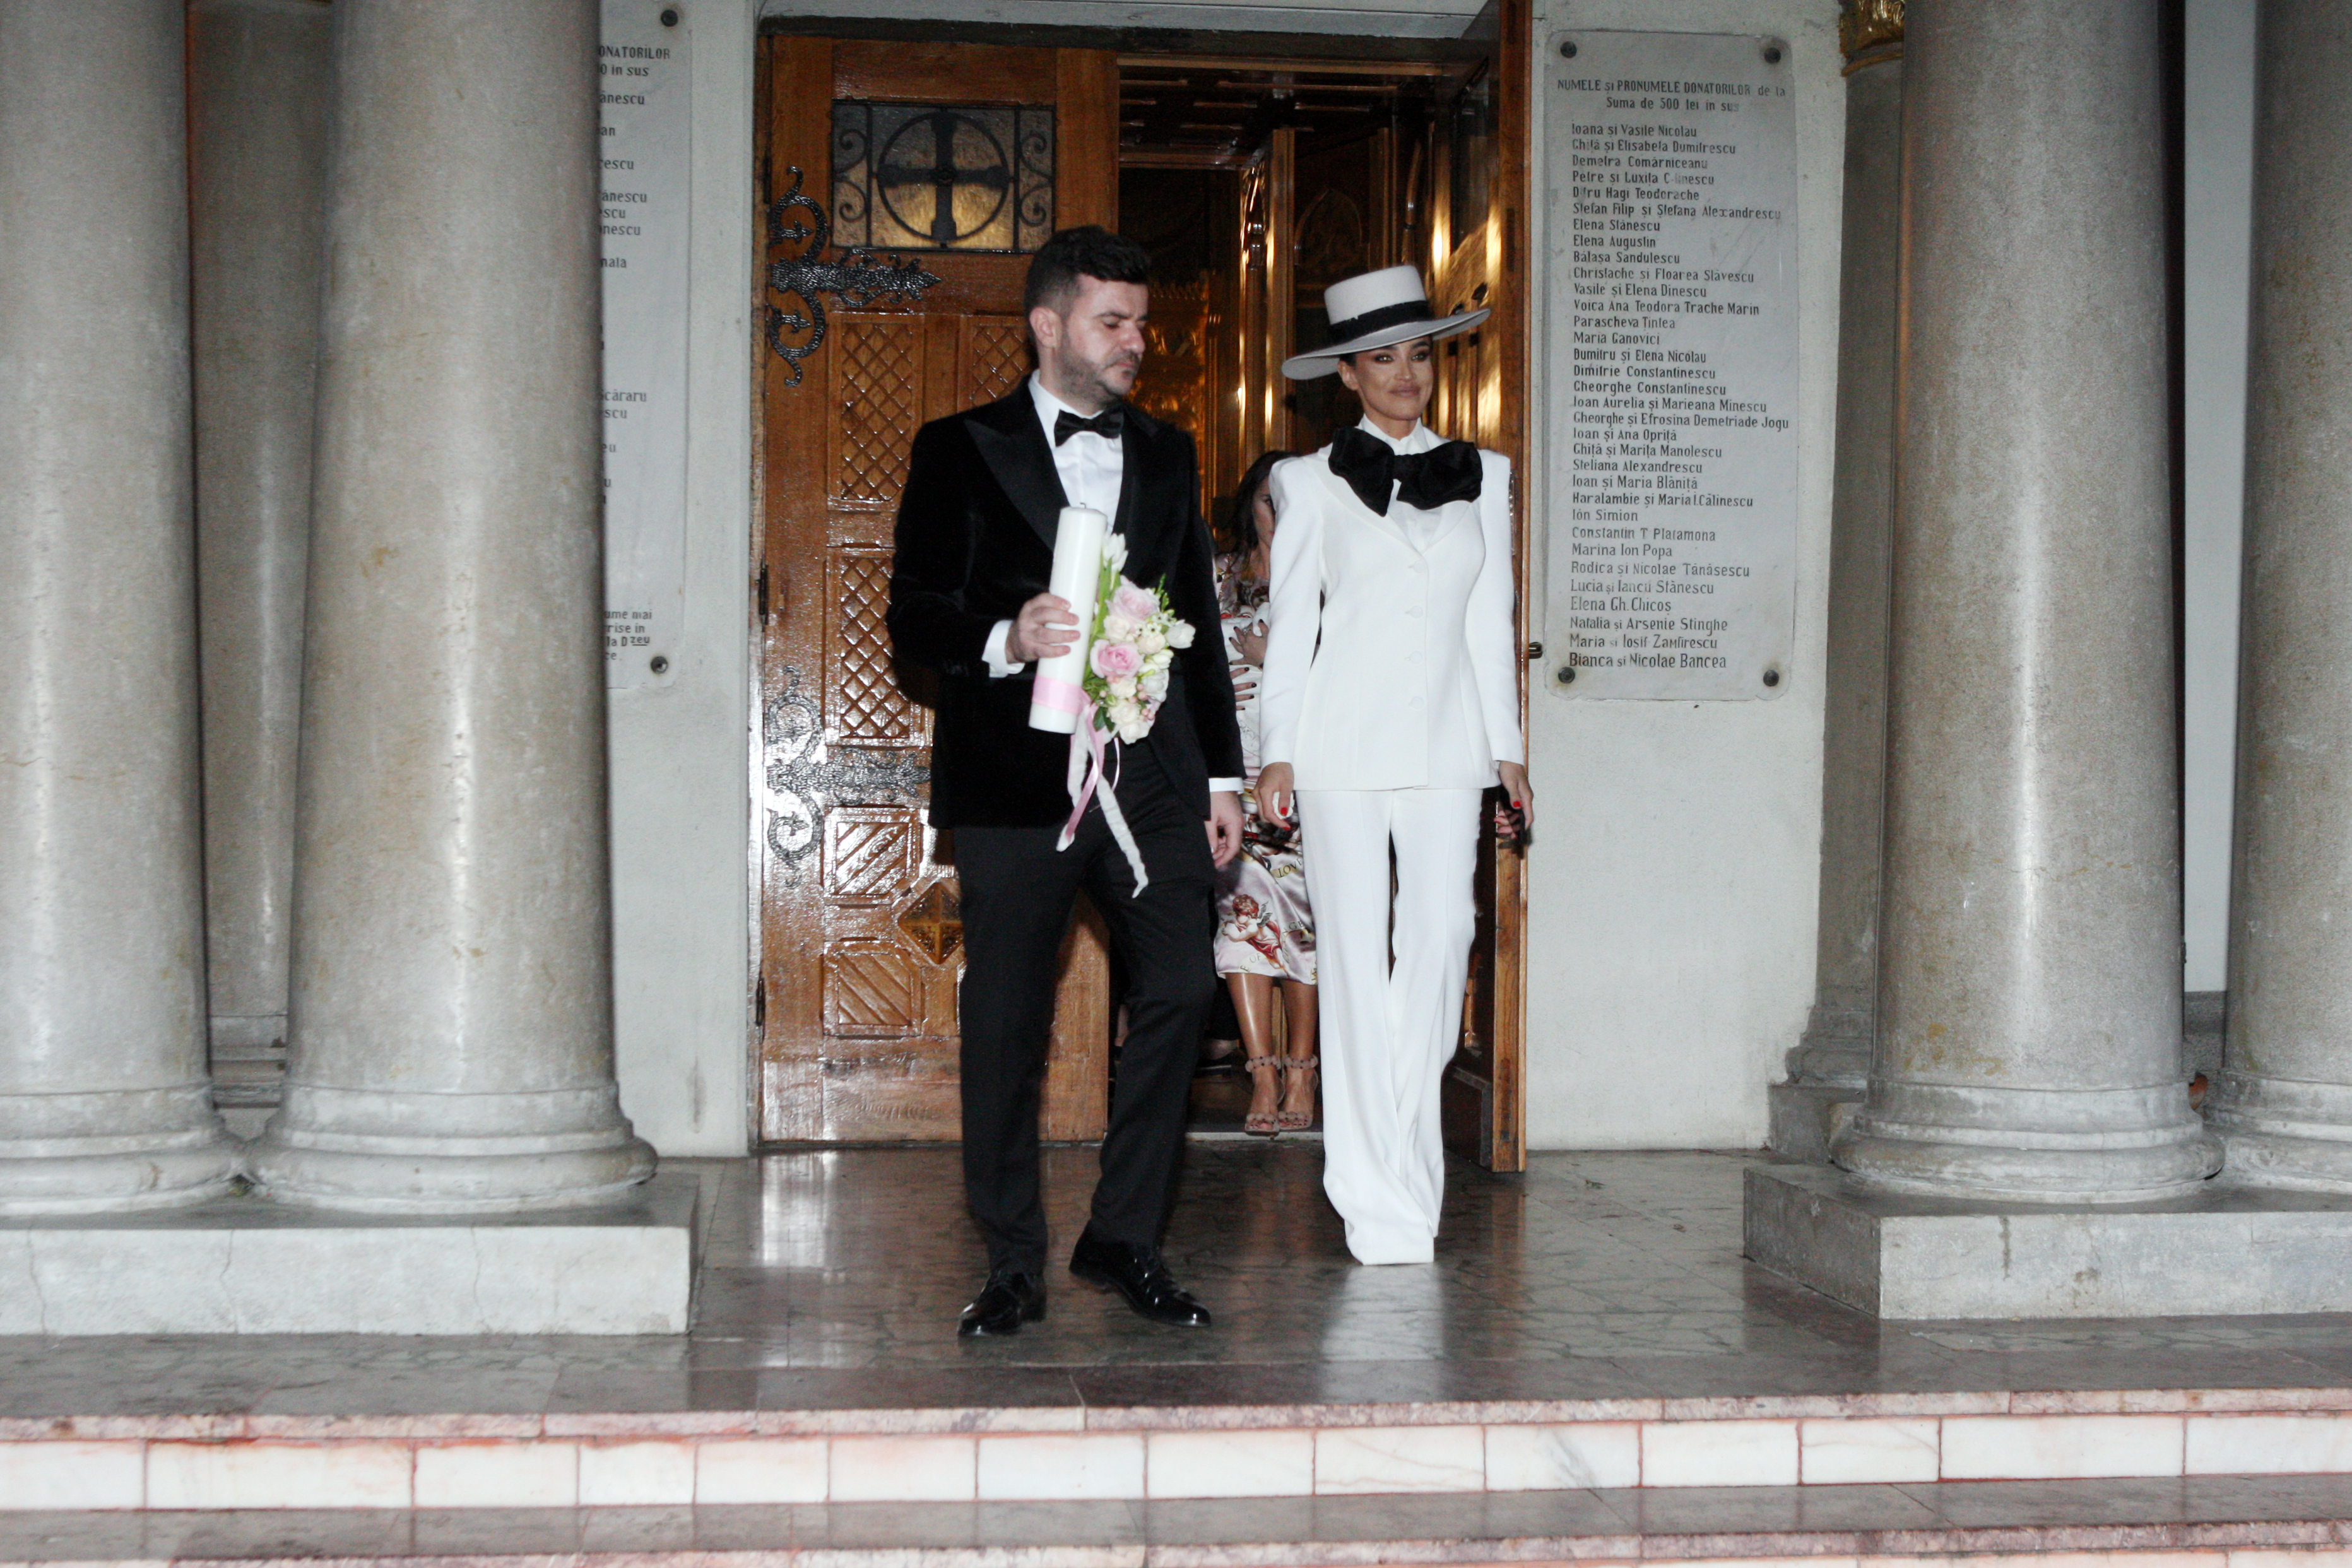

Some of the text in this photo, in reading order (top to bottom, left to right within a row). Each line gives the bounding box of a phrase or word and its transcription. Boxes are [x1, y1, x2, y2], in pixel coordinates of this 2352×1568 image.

[627, 67, 649, 76] sus
[1557, 80, 1601, 91] NUMELE
[1617, 80, 1680, 93] PRONUMELE
[1684, 82, 1751, 95] DONATORILOR
[1759, 85, 1770, 97] de
[1776, 86, 1785, 97] la
[1607, 97, 1635, 109] Suma
[1641, 98, 1653, 110] de
[1660, 98, 1679, 110] 500
[1686, 99, 1698, 110] lei
[1721, 102, 1739, 112] sus
[1572, 123, 1603, 135] Ioana
[1621, 126, 1654, 136] Vasile
[1658, 125, 1696, 137] Nicolau
[1673, 141, 1735, 154] Dumitrescu
[1606, 188, 1629, 201] Hagi
[1613, 203, 1634, 218] Filip
[1702, 206, 1781, 220] Alexandrescu
[1573, 219, 1604, 230] Elena
[1573, 235, 1655, 251] Elena Augustin
[1616, 252, 1680, 264] Sandulescu
[1655, 268, 1698, 281] Floarea
[1574, 283, 1605, 295] Vasile
[1626, 284, 1657, 296] Elena
[1661, 285, 1706, 297] Dinescu
[1574, 300, 1759, 315] Voica Ana Teodora Trache Marin
[1574, 315, 1638, 327] Parascheva
[1574, 331, 1607, 343] Maria
[1574, 348, 1615, 360] Dumitru
[1636, 350, 1664, 362] Elena
[1668, 350, 1706, 363] Nicolau
[1574, 365, 1715, 379] Dimitrie Constantinescu
[1574, 381, 1726, 396] Gheorghe Constantinescu
[1574, 396, 1599, 407] Ioan
[1603, 397, 1644, 409] Aurelia
[1662, 398, 1715, 411] Marieana
[1719, 399, 1766, 413] Minescu
[1574, 411, 1624, 427] Gheorghe
[1641, 413, 1690, 425] Efrosina
[1694, 414, 1758, 428] Demetriade
[1761, 416, 1788, 432] Jogu
[1574, 428, 1599, 439] Ioan
[1618, 430, 1639, 440] Ana
[1660, 445, 1722, 457] Manolescu
[1573, 459, 1703, 473] Steliana Alexandrescu
[1573, 475, 1597, 487] Ioan
[1617, 476, 1652, 488] Maria
[1573, 492, 1640, 505] Haralambie
[1658, 493, 1692, 505] Maria
[1596, 509, 1638, 521] Simion
[1573, 526, 1634, 539] Constantin
[1573, 543, 1672, 560] Marina Ion Popa
[1571, 562, 1613, 574] Rodica
[1633, 563, 1676, 575] Nicolae
[1571, 579, 1603, 592] Lucia
[1618, 580, 1652, 592] Iancu
[1571, 596, 1605, 611] Elena
[1570, 616, 1610, 629] Natalia
[1626, 618, 1675, 630] Arsenie
[1681, 618, 1727, 636] Stinghe
[1570, 634, 1605, 647] Maria
[1623, 634, 1648, 648] Iosif
[1569, 652, 1613, 667] Bianca
[1629, 653, 1675, 668] Nicolae
[1681, 654, 1726, 668] Bancea
